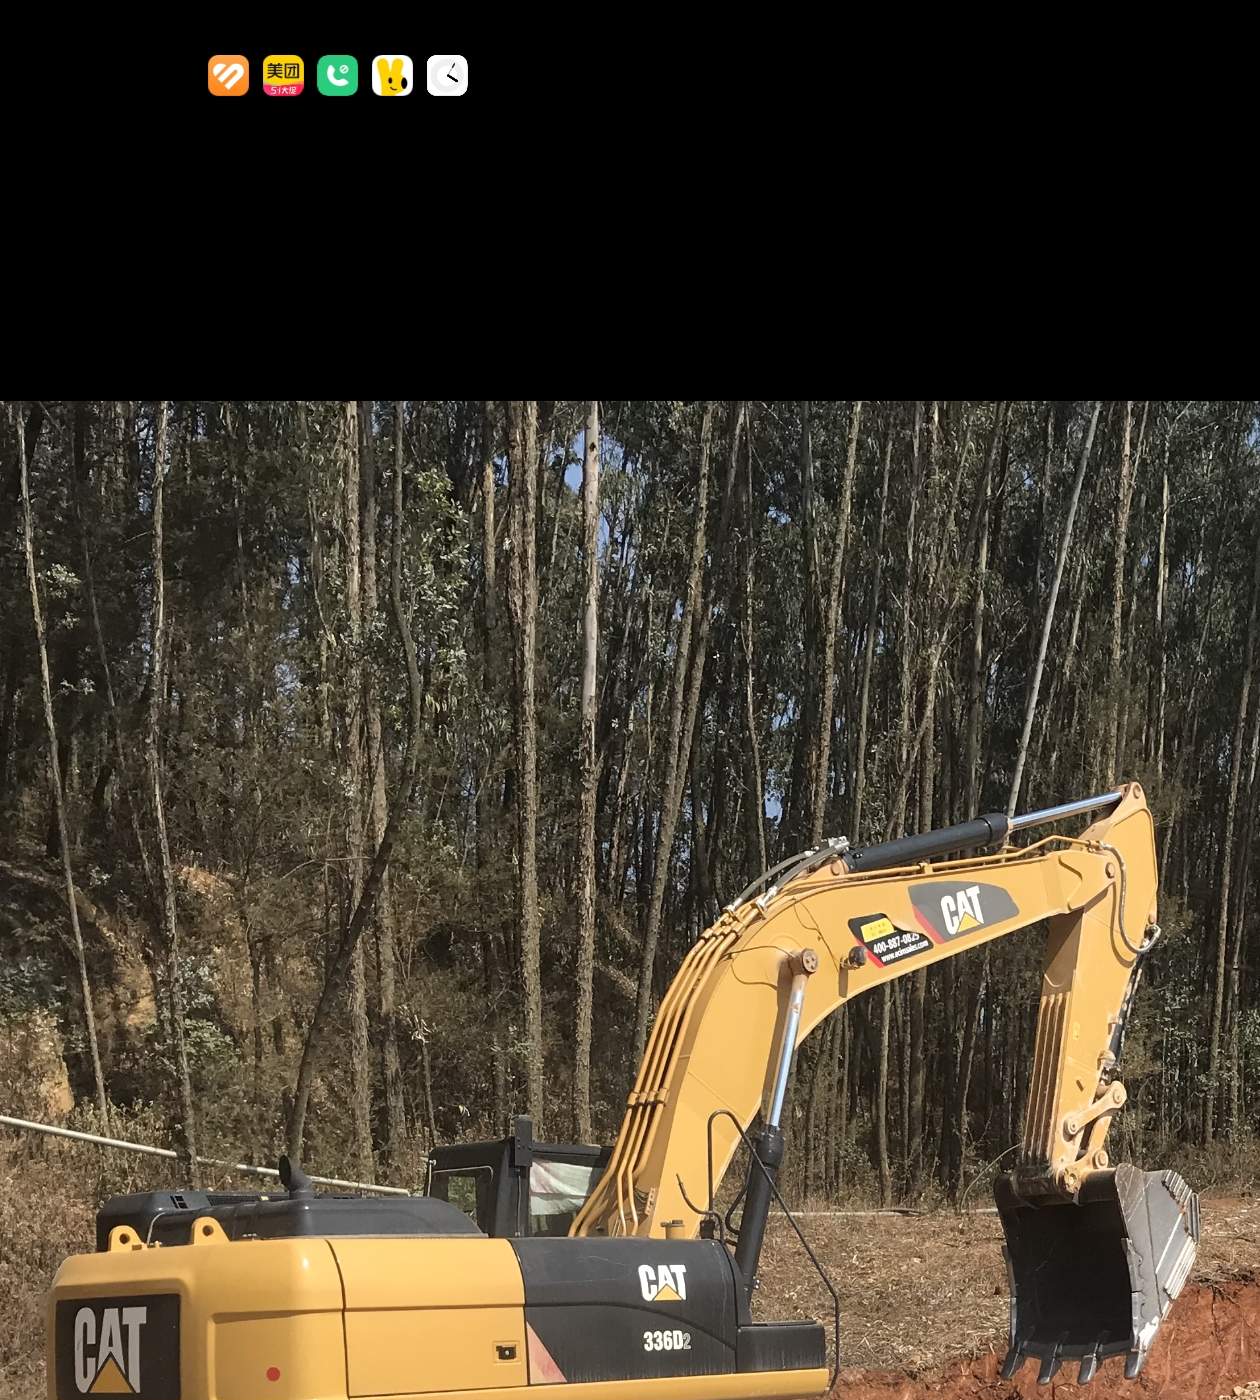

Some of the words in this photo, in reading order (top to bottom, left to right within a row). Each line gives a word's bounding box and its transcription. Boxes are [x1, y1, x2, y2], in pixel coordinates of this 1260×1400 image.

[940, 886, 984, 935] CAT
[638, 1264, 687, 1301] CAT
[74, 1306, 147, 1394] CAT
[643, 1330, 692, 1351] 336D2
